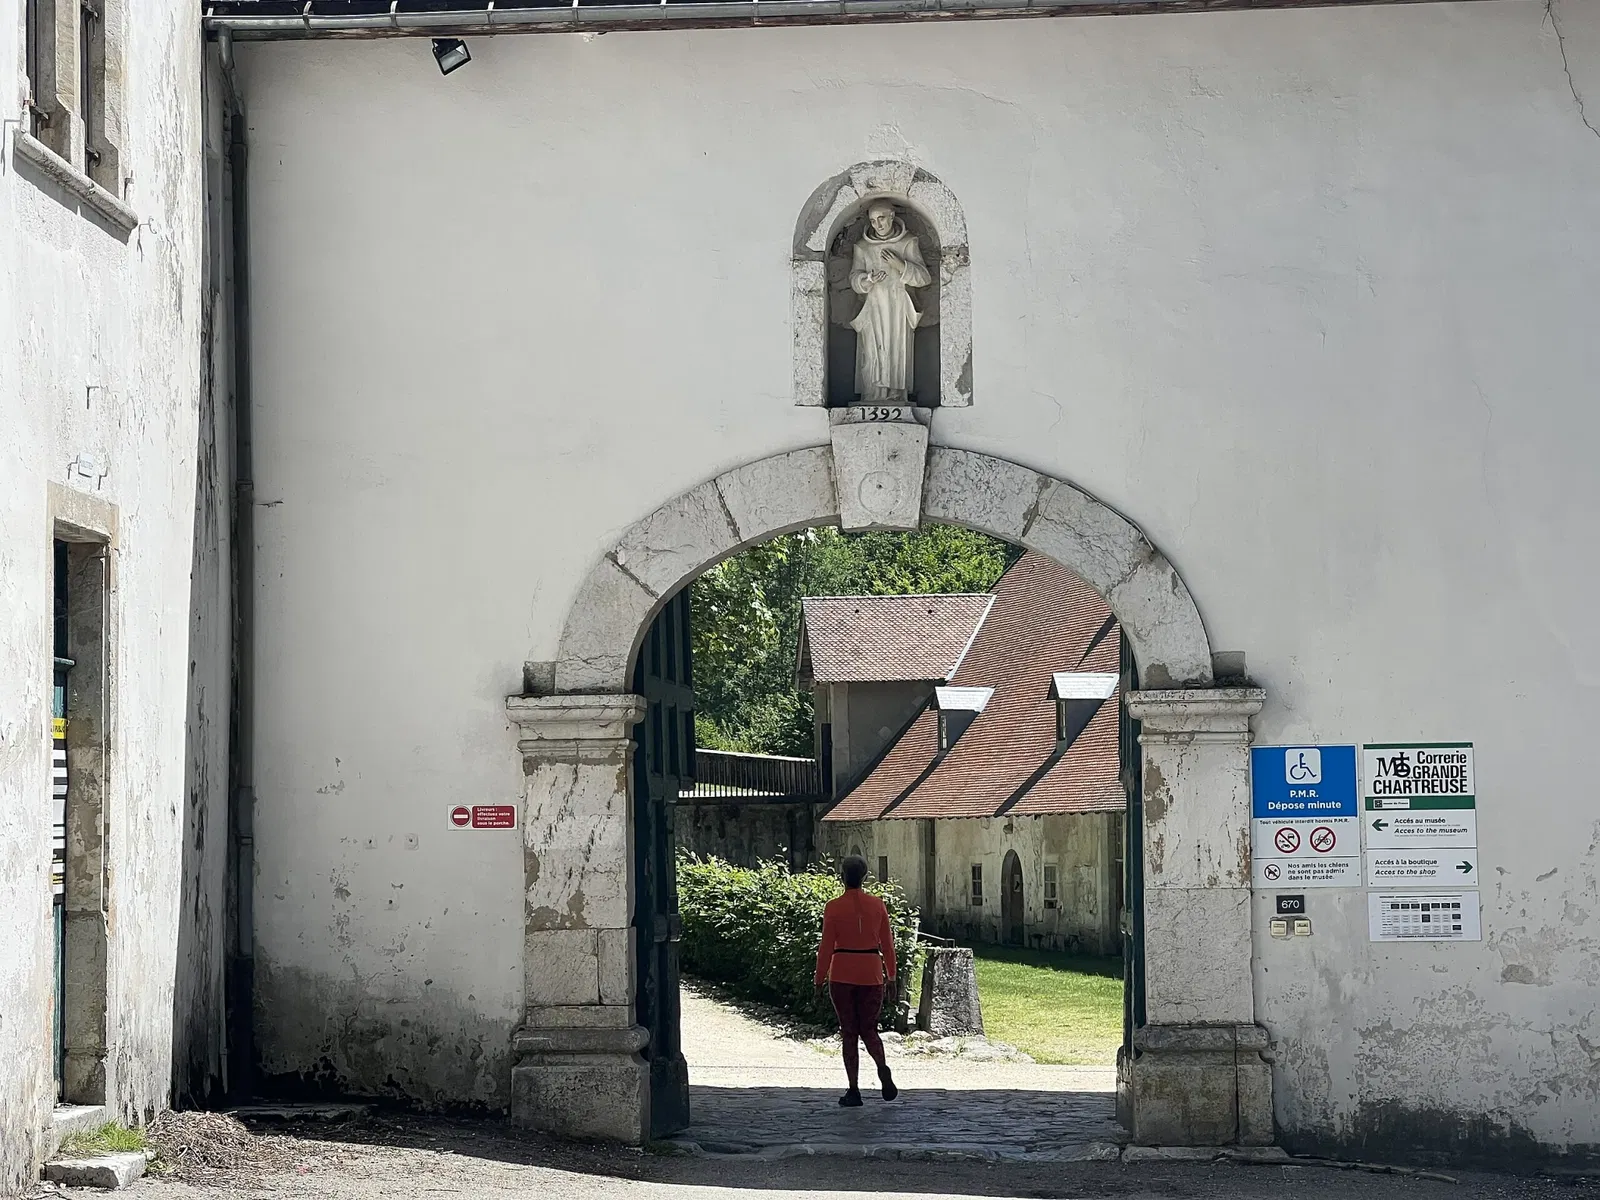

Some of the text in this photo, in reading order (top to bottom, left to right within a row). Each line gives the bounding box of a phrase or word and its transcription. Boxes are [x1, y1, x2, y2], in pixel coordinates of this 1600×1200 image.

[860, 407, 902, 420] 1392
[1417, 750, 1467, 764] Correrie
[1412, 765, 1467, 779] GRANDE
[1373, 779, 1468, 794] CHARTREUSE
[1290, 790, 1319, 798] P.M.R.
[1268, 801, 1342, 811] Dépose minute
[1419, 868, 1437, 876] shop
[1281, 899, 1300, 909] 670
